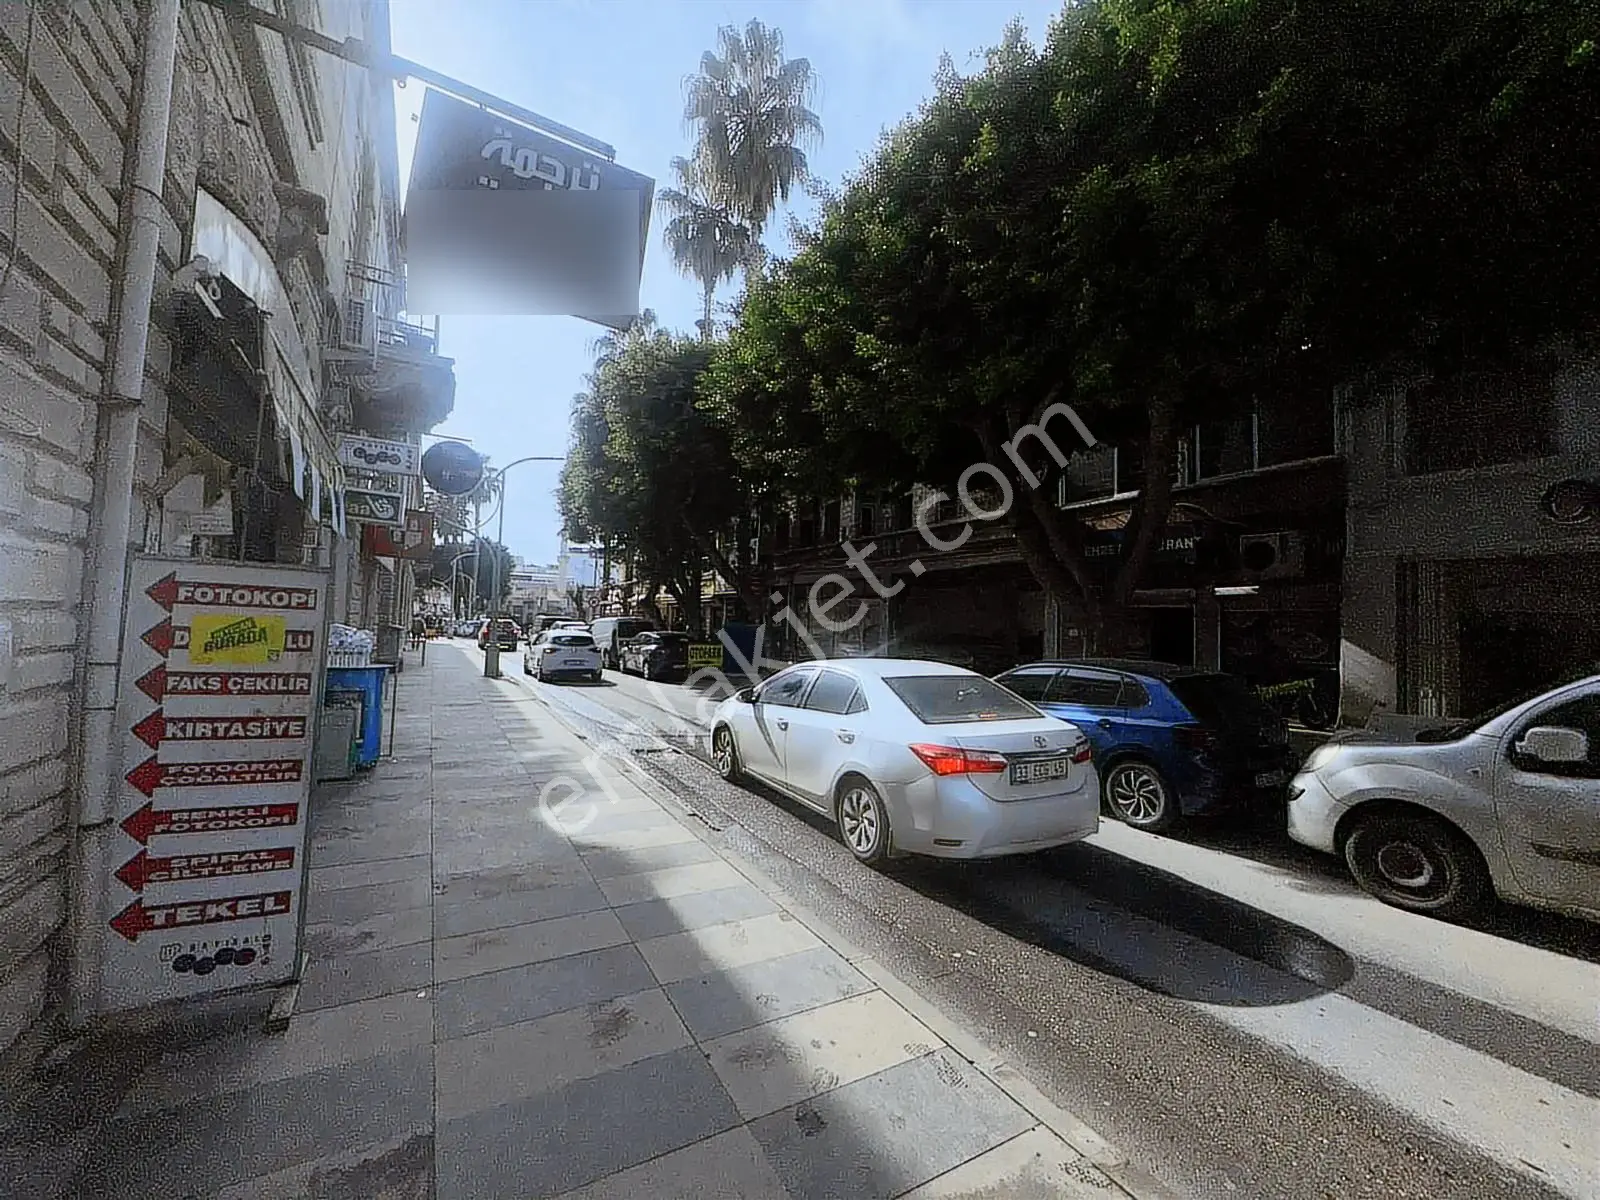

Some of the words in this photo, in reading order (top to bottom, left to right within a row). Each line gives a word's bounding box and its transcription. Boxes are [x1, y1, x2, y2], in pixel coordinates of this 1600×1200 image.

[177, 586, 316, 607] FOTOKOPİ
[167, 676, 221, 691] FAKS
[227, 674, 309, 694] ÇEKİLİR
[165, 718, 304, 738] KIRTASİYE
[147, 898, 286, 926] TEKEL
